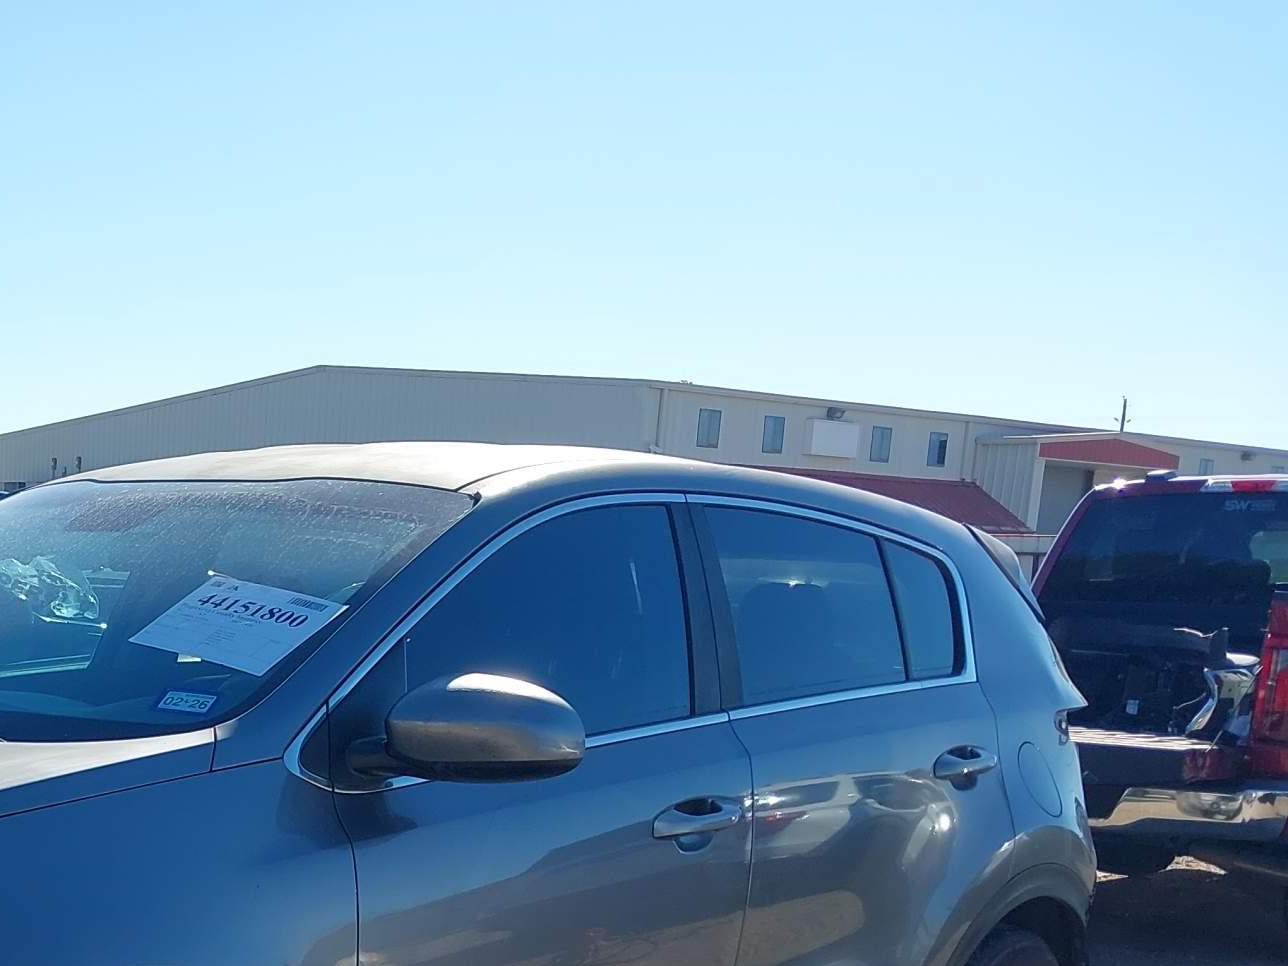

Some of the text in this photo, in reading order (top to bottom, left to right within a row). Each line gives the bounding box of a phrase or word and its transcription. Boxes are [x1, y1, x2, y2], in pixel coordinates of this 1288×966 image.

[197, 593, 310, 628] 44151800
[163, 696, 185, 707] 02
[188, 698, 209, 710] 26
